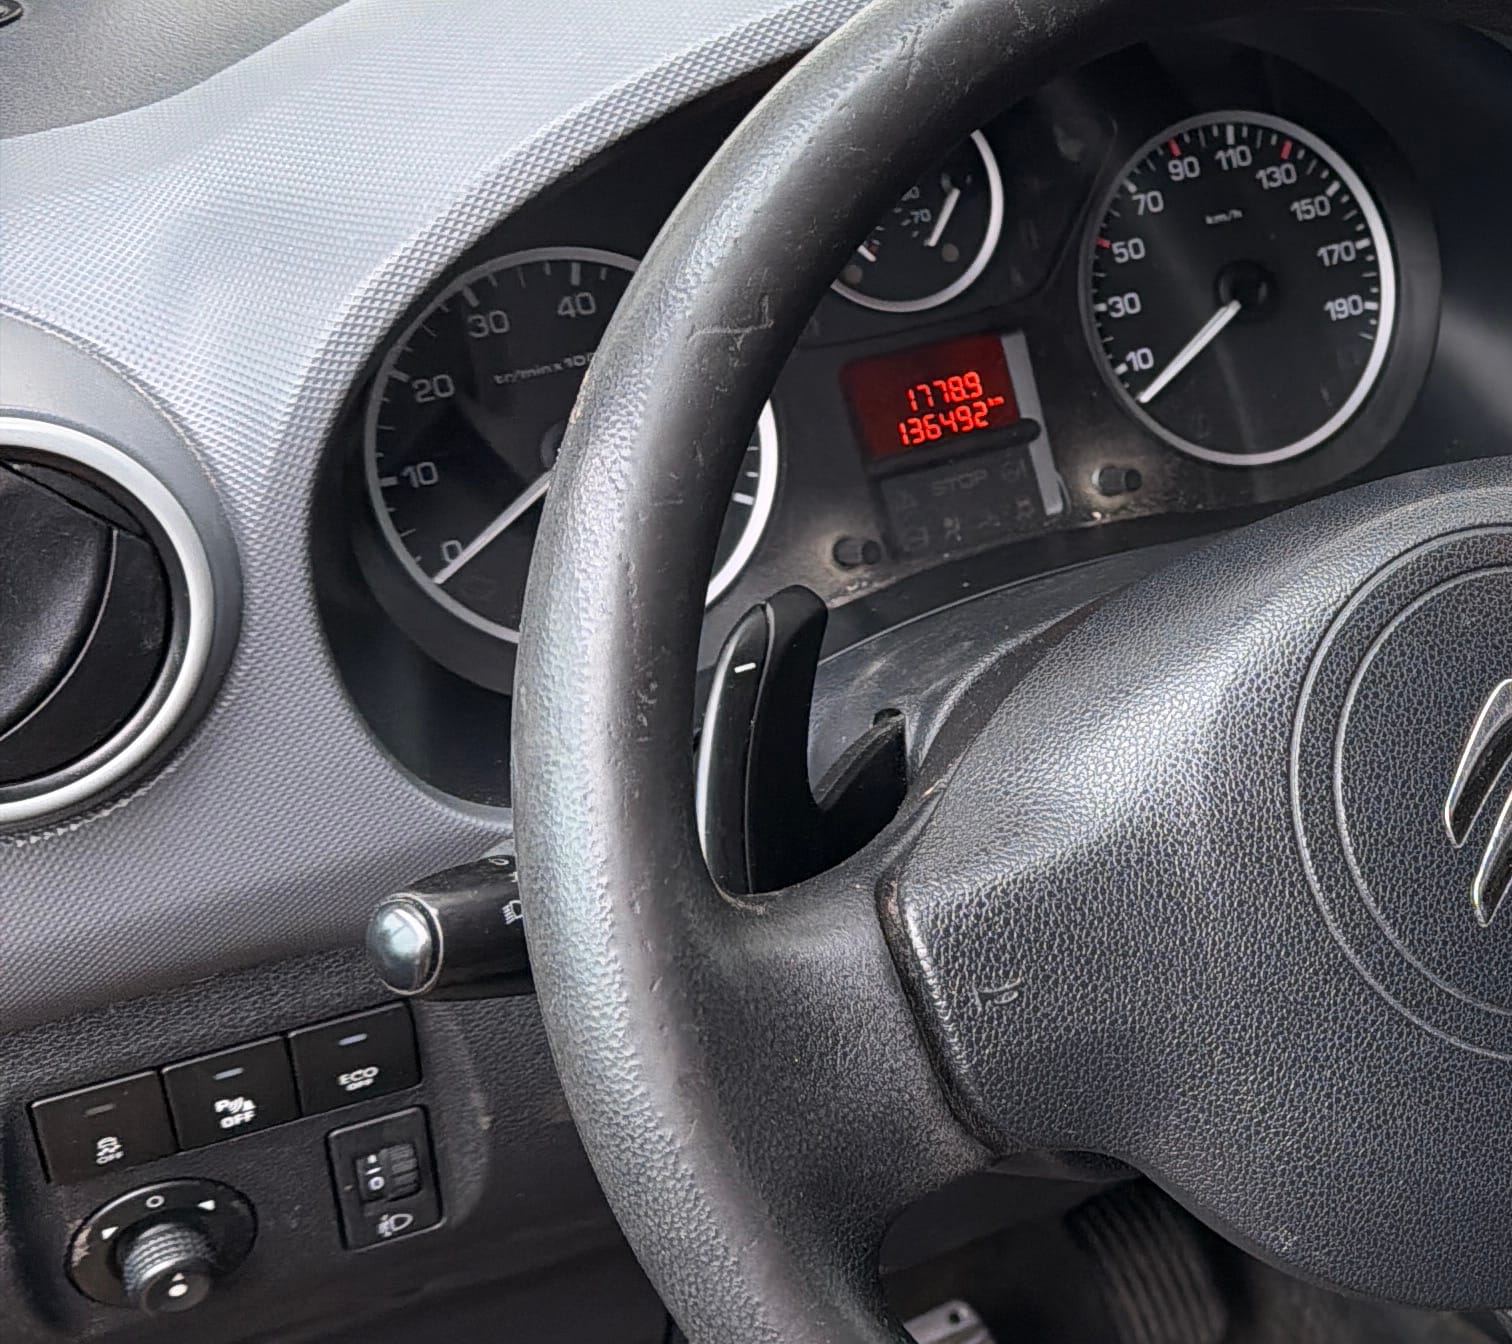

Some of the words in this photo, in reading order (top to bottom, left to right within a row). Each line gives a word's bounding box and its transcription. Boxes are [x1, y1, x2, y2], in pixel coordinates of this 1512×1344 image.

[1168, 156, 1200, 181] 90
[1215, 145, 1252, 170] 110
[1256, 163, 1297, 189] 130
[1132, 190, 1164, 215] 70
[1290, 195, 1331, 222] 150
[1205, 209, 1243, 225] km/h
[1112, 237, 1146, 263] 50
[1317, 241, 1356, 267] 170
[557, 292, 597, 318] 40
[1108, 292, 1142, 318] 30
[1324, 295, 1363, 321] 190
[466, 310, 510, 338] 30
[1125, 347, 1154, 371] 10
[412, 374, 455, 403] 20
[898, 401, 989, 446] 136492
[402, 461, 439, 489] 10
[440, 540, 463, 563] 0
[338, 1066, 379, 1086] ECO
[219, 1110, 257, 1129] OFF
